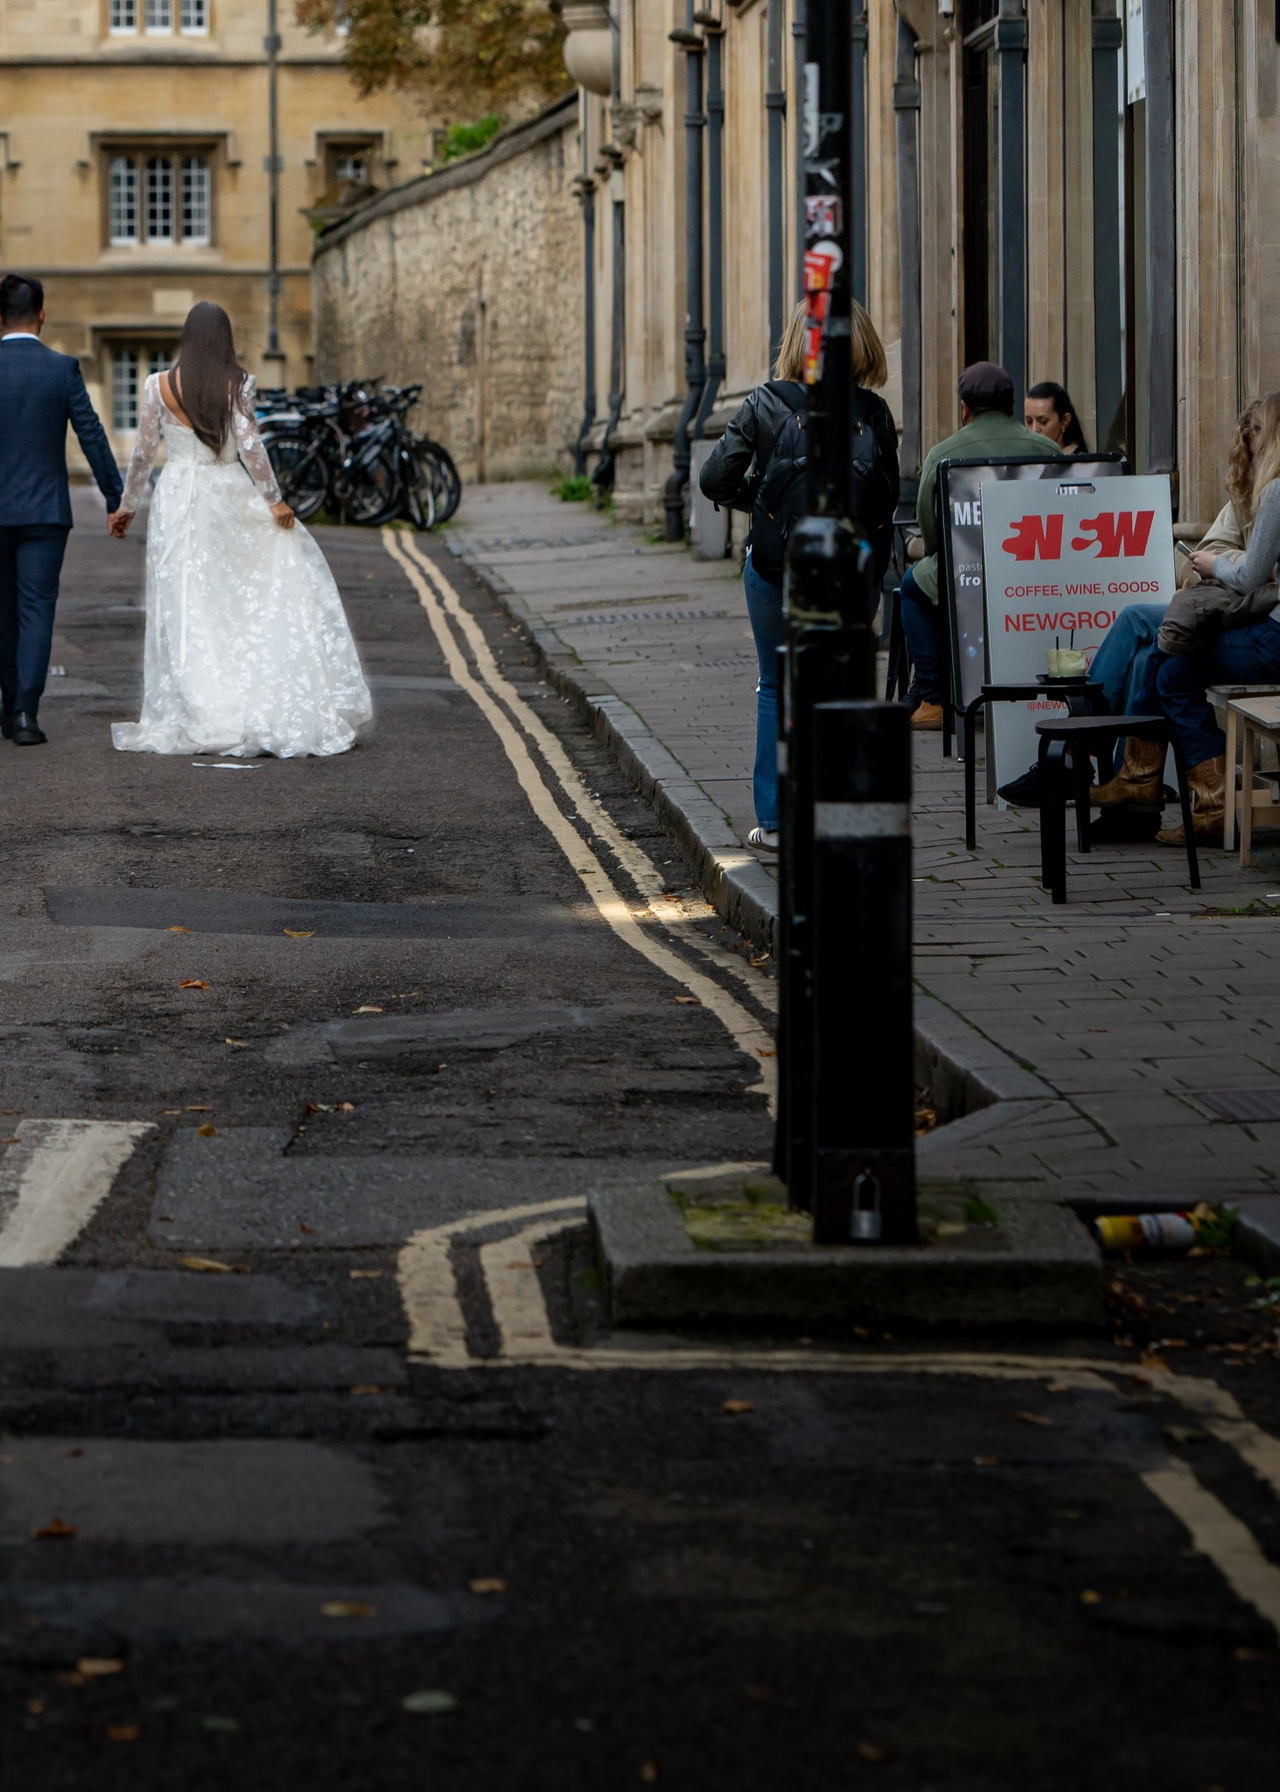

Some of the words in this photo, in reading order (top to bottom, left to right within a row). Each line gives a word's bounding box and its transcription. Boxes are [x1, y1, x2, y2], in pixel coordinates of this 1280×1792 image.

[1004, 585, 1063, 599] COFFEE,
[1065, 582, 1105, 596] WINE,
[1107, 581, 1159, 594] GOODS
